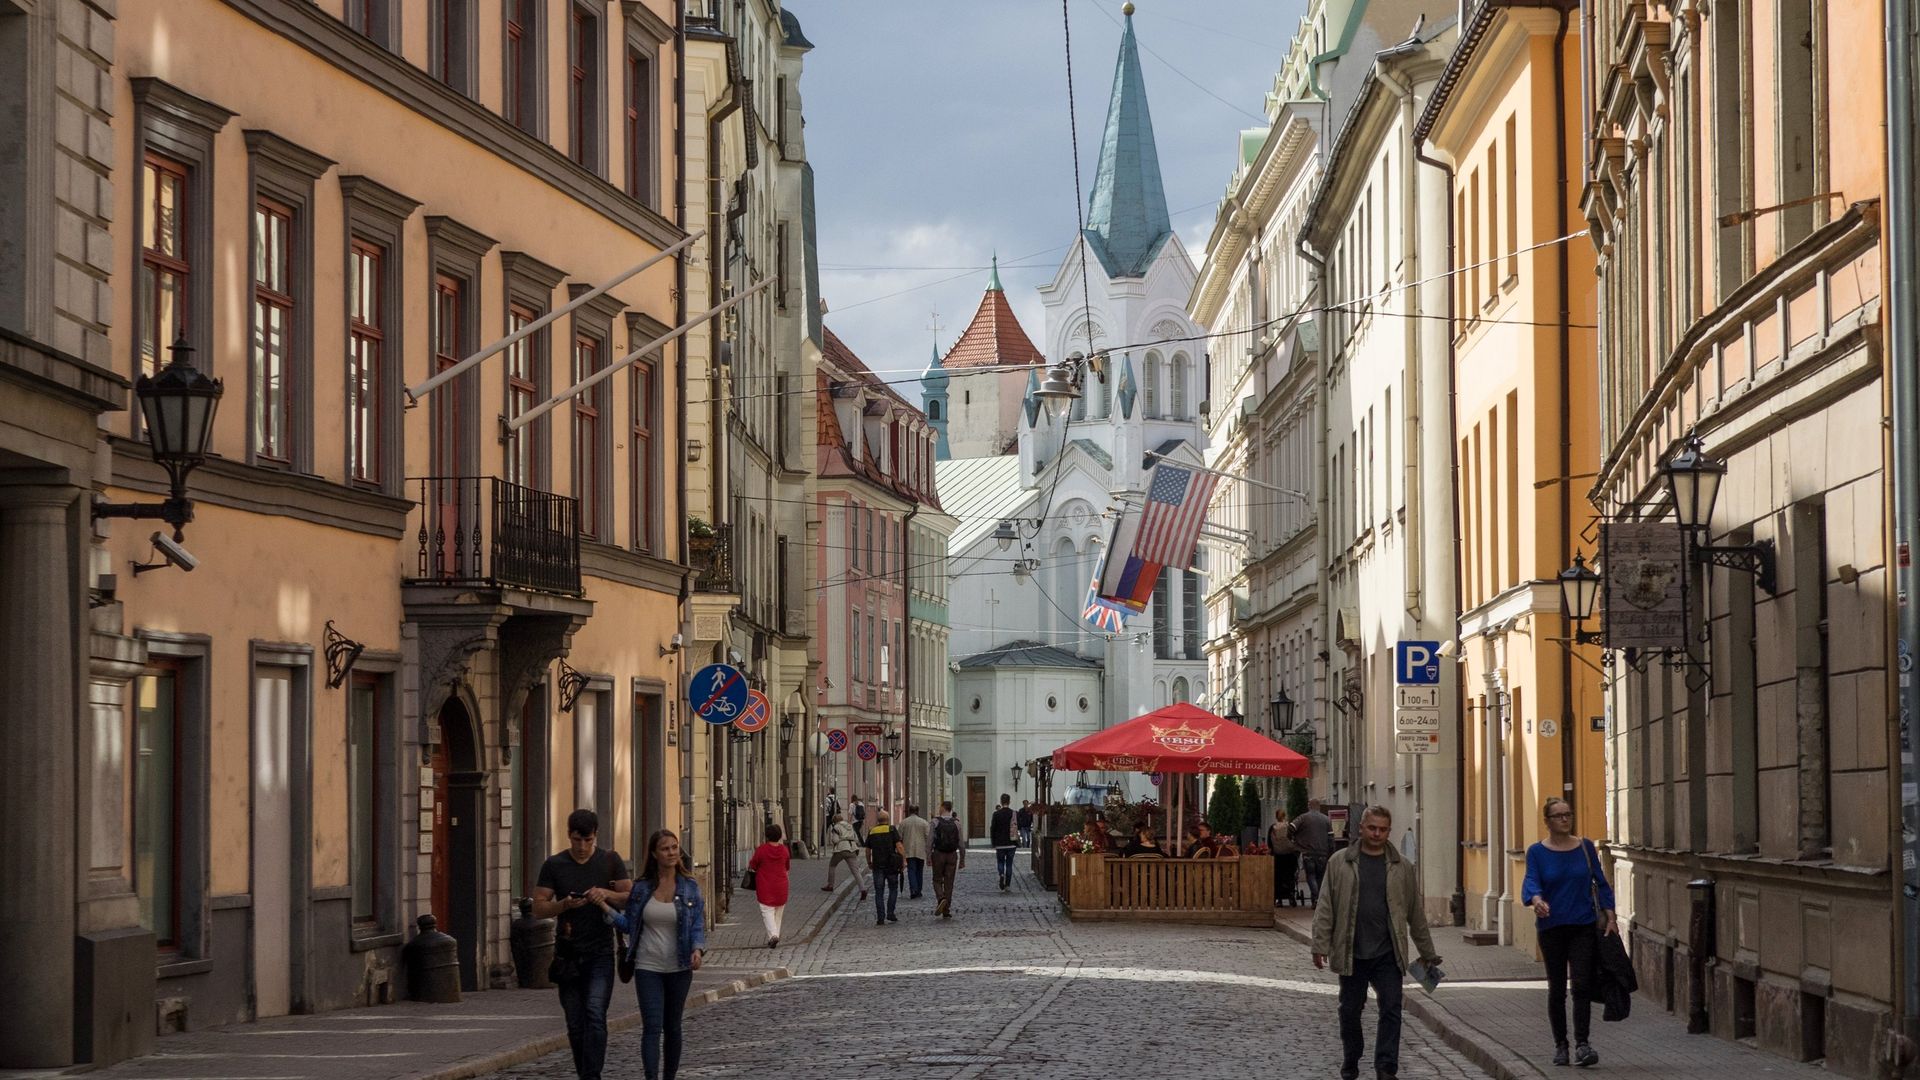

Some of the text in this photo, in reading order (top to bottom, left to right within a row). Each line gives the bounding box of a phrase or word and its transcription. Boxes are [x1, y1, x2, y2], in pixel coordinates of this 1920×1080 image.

[1406, 646, 1430, 679] P
[1408, 696, 1421, 704] 100
[1400, 716, 1437, 725] 6.00-24.00
[1234, 760, 1243, 769] ir
